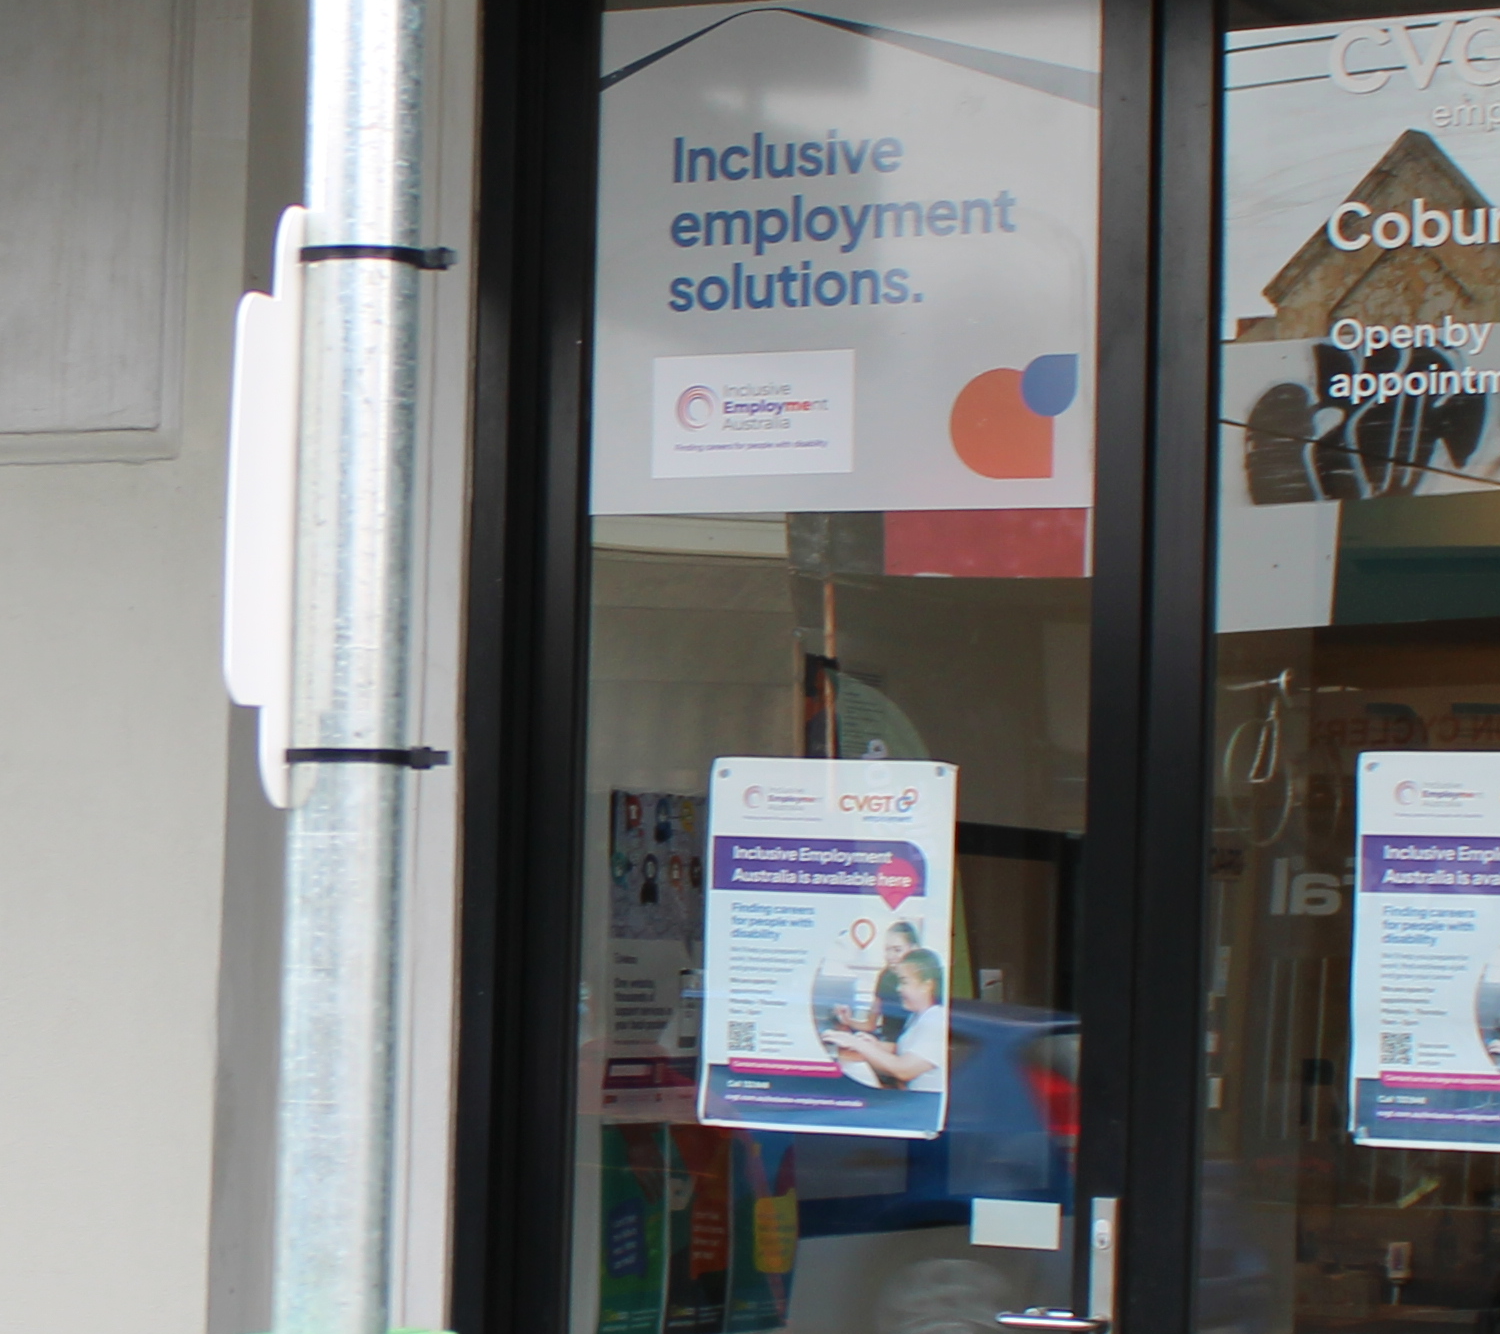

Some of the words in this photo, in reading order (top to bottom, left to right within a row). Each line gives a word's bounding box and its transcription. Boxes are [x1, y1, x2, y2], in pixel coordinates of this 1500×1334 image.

[672, 126, 903, 185] Inclusive
[669, 187, 1016, 255] employment
[668, 259, 925, 314] solutions.
[1330, 314, 1436, 362] Open
[1441, 314, 1492, 357] by
[723, 398, 829, 417] Employment
[838, 794, 895, 813] CVGT
[732, 844, 798, 862] Inclusive
[798, 847, 893, 867] Employment
[1382, 843, 1456, 861] Inclusive
[731, 867, 797, 884] Australia
[798, 869, 811, 885] is
[811, 870, 877, 887] available
[877, 872, 912, 888] here
[1382, 868, 1455, 885] Australia
[1456, 870, 1471, 886] is
